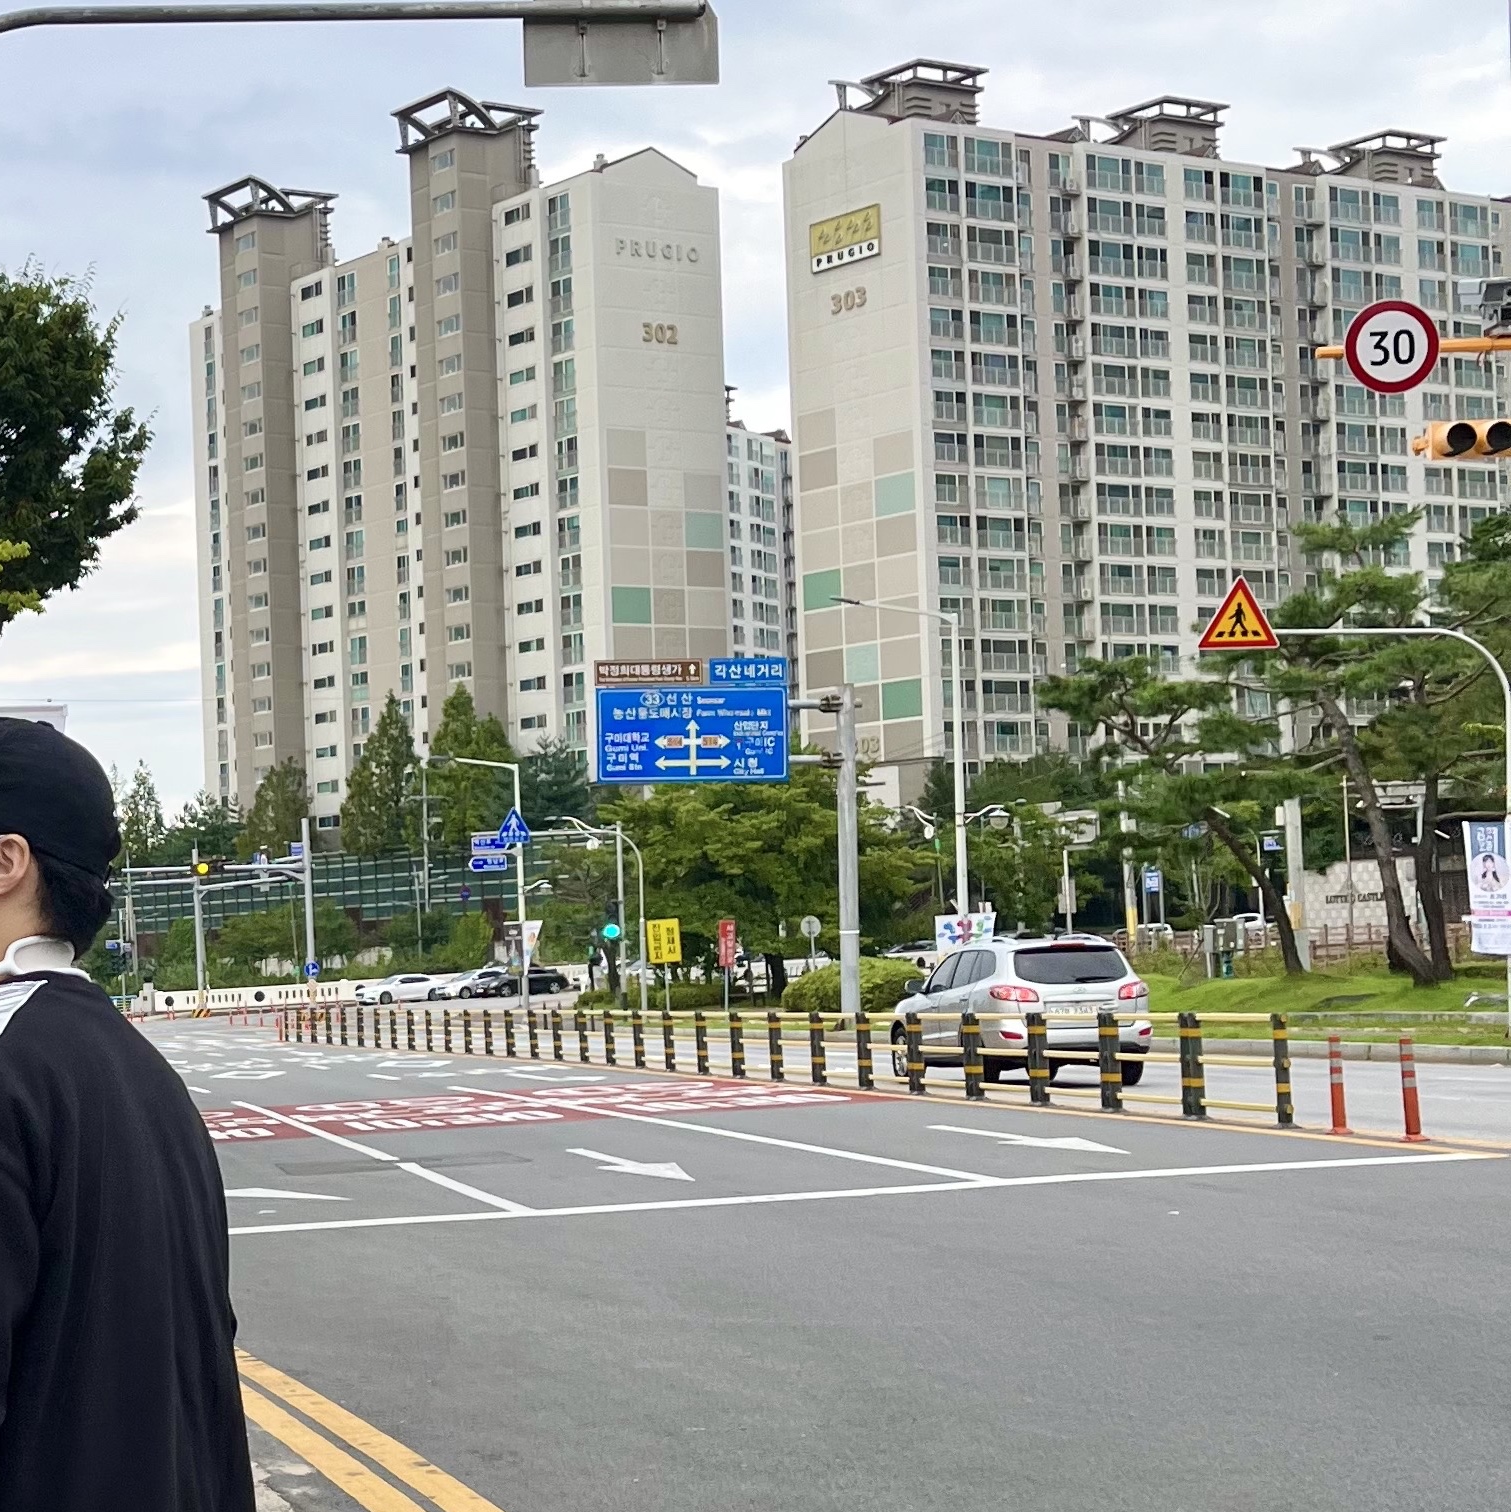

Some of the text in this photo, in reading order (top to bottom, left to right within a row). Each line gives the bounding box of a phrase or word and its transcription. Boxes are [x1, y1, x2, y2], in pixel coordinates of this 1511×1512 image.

[615, 239, 699, 263] PRUGIO
[816, 242, 875, 267] PRUGIO
[831, 286, 867, 315] 303
[642, 322, 678, 345] 302
[1369, 329, 1415, 366] 30
[598, 663, 682, 678] 박정희대통령생가
[714, 664, 783, 680] 각산네거리
[645, 695, 660, 704] 33
